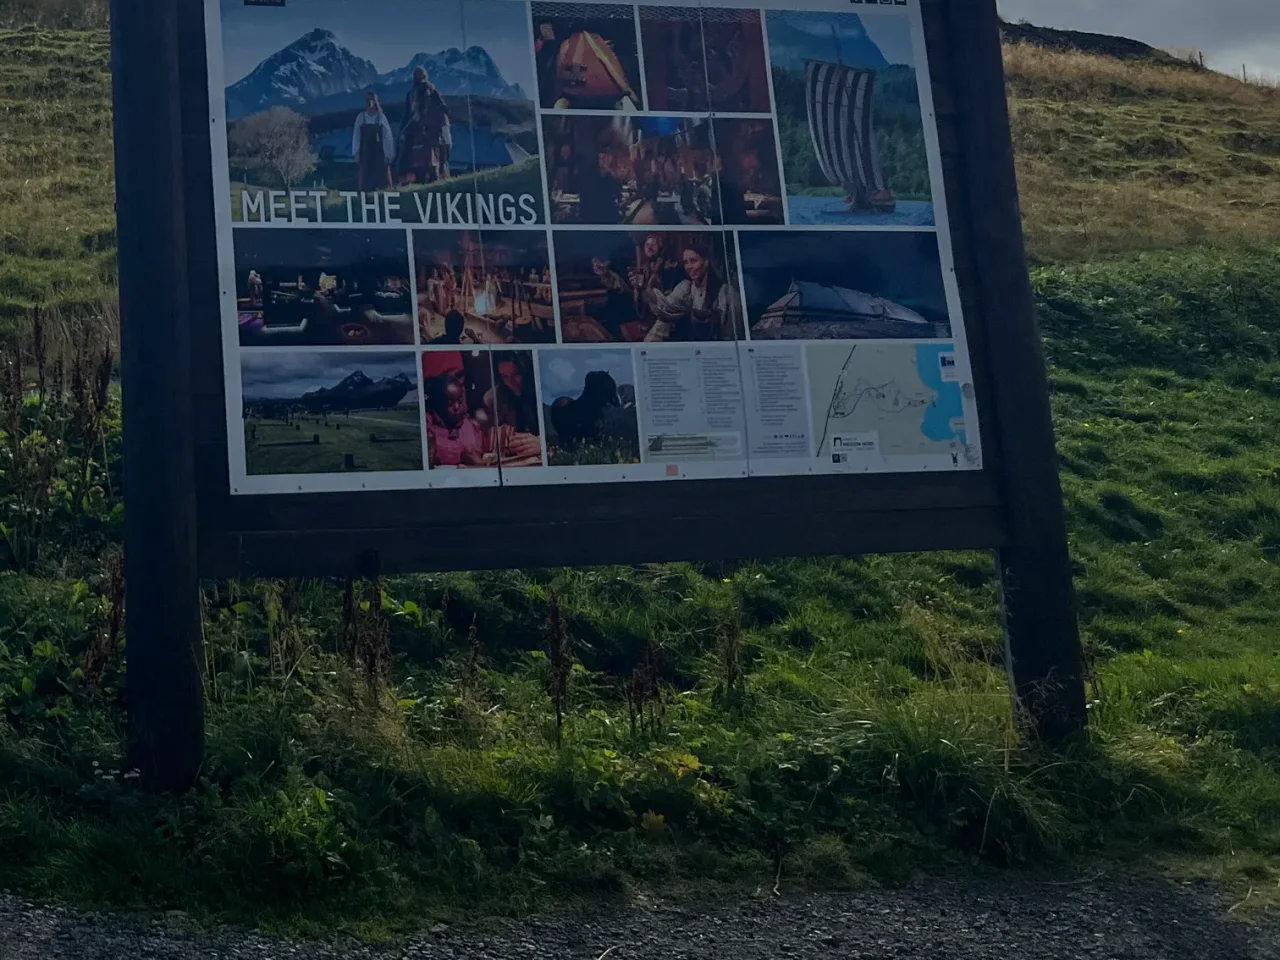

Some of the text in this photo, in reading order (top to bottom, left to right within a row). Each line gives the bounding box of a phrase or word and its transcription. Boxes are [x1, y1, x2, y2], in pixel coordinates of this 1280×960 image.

[241, 190, 537, 226] MEET THE VIKINGS
